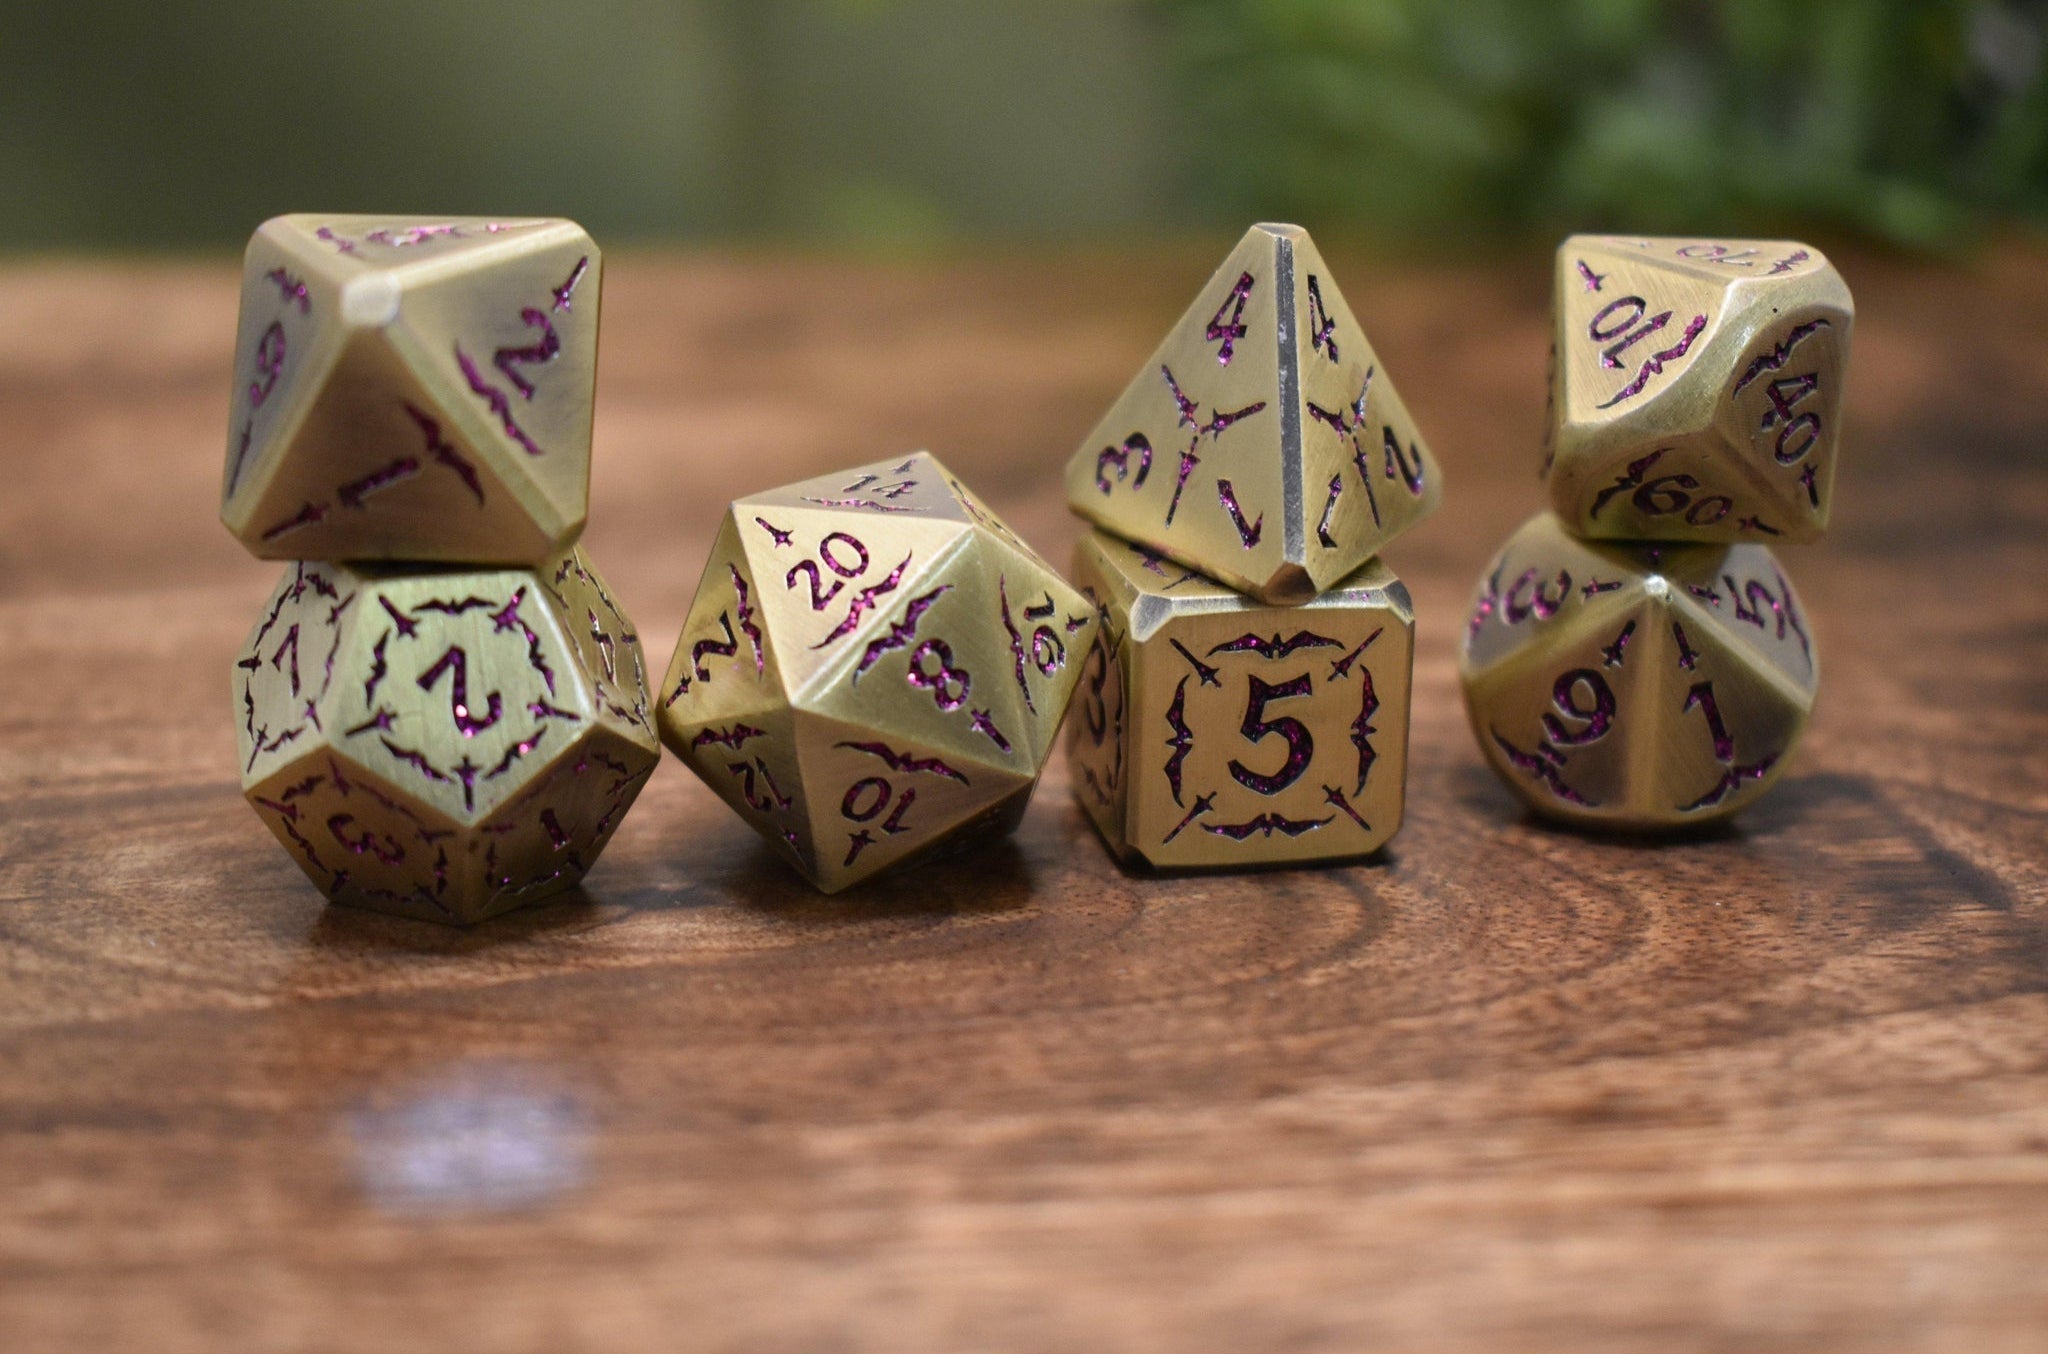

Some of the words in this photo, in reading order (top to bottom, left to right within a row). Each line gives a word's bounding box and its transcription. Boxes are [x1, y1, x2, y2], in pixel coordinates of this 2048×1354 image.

[1206, 271, 1255, 367] 4
[1307, 274, 1338, 364] 4
[1590, 295, 1673, 369] 10
[1761, 372, 1821, 465] 40
[1095, 432, 1153, 496] 3
[1383, 425, 1425, 495] 2
[1632, 474, 1733, 526] 60
[786, 531, 870, 612] 20
[1503, 567, 1572, 626] 3
[908, 637, 971, 712] 8
[1542, 668, 1617, 747] 9
[1227, 672, 1314, 797] 5
[1682, 681, 1734, 764] 1
[841, 776, 915, 835] 10
